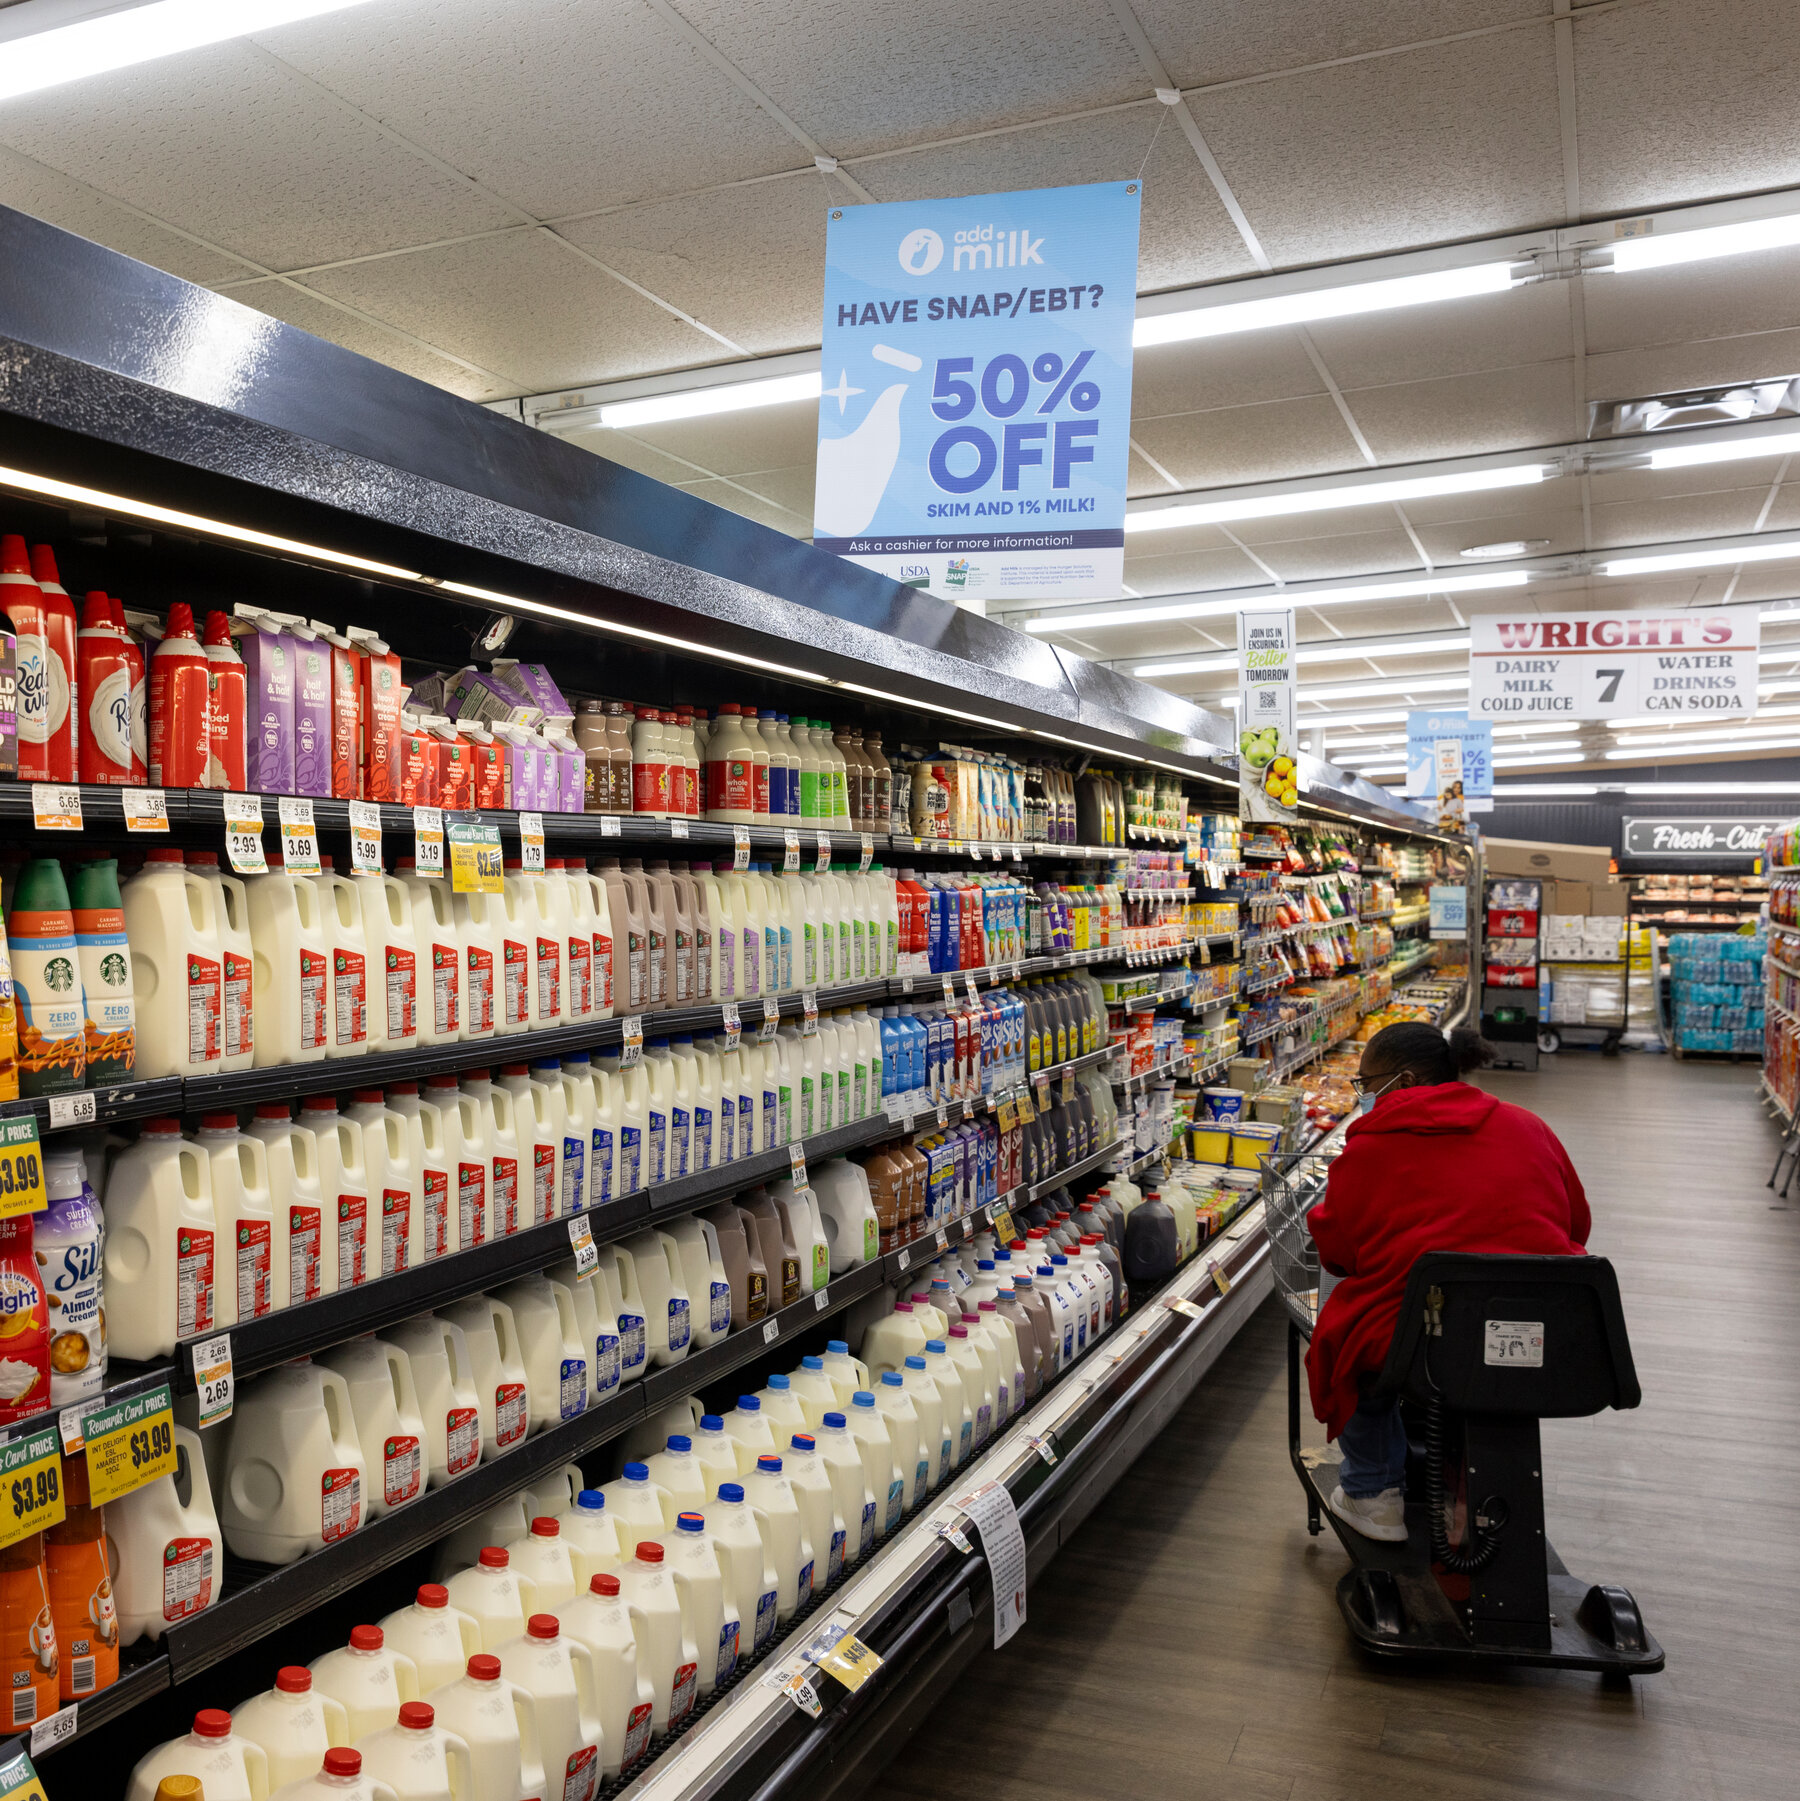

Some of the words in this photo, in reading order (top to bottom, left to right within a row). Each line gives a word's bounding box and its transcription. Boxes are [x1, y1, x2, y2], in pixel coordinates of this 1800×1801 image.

[954, 224, 992, 243] add
[953, 230, 1045, 272] milk
[837, 299, 918, 327] HAVE
[927, 284, 1104, 320] SNAP/EBT?
[930, 350, 1100, 422] 50%
[928, 420, 1099, 494] OFF
[927, 503, 970, 518] SKIM
[974, 502, 1014, 516] AND
[1018, 500, 1041, 514] 1%
[1045, 498, 1095, 514] MILK!
[849, 540, 871, 552] Ask
[874, 542, 882, 551] a
[885, 538, 932, 551] cashier
[935, 538, 953, 549] for
[956, 540, 990, 548] more
[993, 534, 1073, 548] information!
[900, 566, 930, 578] USDA
[1250, 628, 1264, 638] JOIN
[1266, 628, 1274, 638] US
[1275, 628, 1282, 637] IN
[1496, 616, 1733, 648] WRIGHT'S
[1248, 640, 1279, 649] ENSURING
[1280, 640, 1284, 648] A
[1246, 650, 1287, 668] Better
[1658, 656, 1732, 669] WATER
[1496, 660, 1560, 674] DAIRY
[271, 672, 287, 683] half
[1246, 669, 1289, 681] TOMORROW
[267, 684, 274, 694] &
[275, 684, 290, 696] half
[306, 679, 321, 690] half
[1503, 680, 1553, 692] MILK
[1596, 670, 1624, 702] 7
[1653, 676, 1736, 690] DRINKS
[303, 689, 310, 699] &
[311, 690, 325, 701] half
[1646, 696, 1685, 710] CAN
[1688, 694, 1742, 709] SODA
[1481, 698, 1523, 711] COLD
[1528, 697, 1573, 710] JUICE
[1463, 768, 1485, 784] FF
[59, 796, 79, 808] 6.65
[147, 800, 164, 811] 3.89
[294, 808, 309, 816] 3.69
[233, 836, 256, 853] 2.99
[1653, 824, 1772, 850] Fresh-Cut
[289, 840, 311, 855] 3.69
[357, 842, 376, 858] 5.99
[421, 844, 438, 859] 3.19
[526, 848, 540, 861] 1.79
[738, 852, 748, 863] 1.99
[1444, 905, 1463, 913] 50%
[1444, 912, 1463, 921] OFF
[49, 1011, 77, 1022] ZERO
[104, 1005, 130, 1016] ZERO
[626, 1047, 639, 1060] 3.19
[74, 1103, 94, 1116] 6.85
[7, 1124, 33, 1142] PRICE
[55, 1245, 98, 1291] Sil
[61, 1298, 98, 1315] Almon
[68, 1311, 98, 1323] Creame
[210, 1345, 226, 1358] 2.69
[205, 1380, 229, 1404] 2.69
[87, 1411, 124, 1436] Rewards
[124, 1400, 144, 1422] Card
[145, 1393, 167, 1412] PRICE
[5, 1444, 27, 1468] Card
[29, 1436, 54, 1458] PRICE
[92, 1445, 101, 1454] INT
[102, 1435, 127, 1450] DELIGHT
[130, 1422, 171, 1470] $3.99
[96, 1452, 127, 1470] AMARETTO
[106, 1449, 117, 1458] ESL
[106, 1465, 120, 1476] 32OZ
[11, 1467, 58, 1519] $3.99
[179, 1545, 192, 1553] whole
[843, 1642, 868, 1664] $4.59
[796, 1686, 813, 1705] 4.99
[53, 1717, 74, 1736] 5.65
[0, 1763, 30, 1790] PRICE
